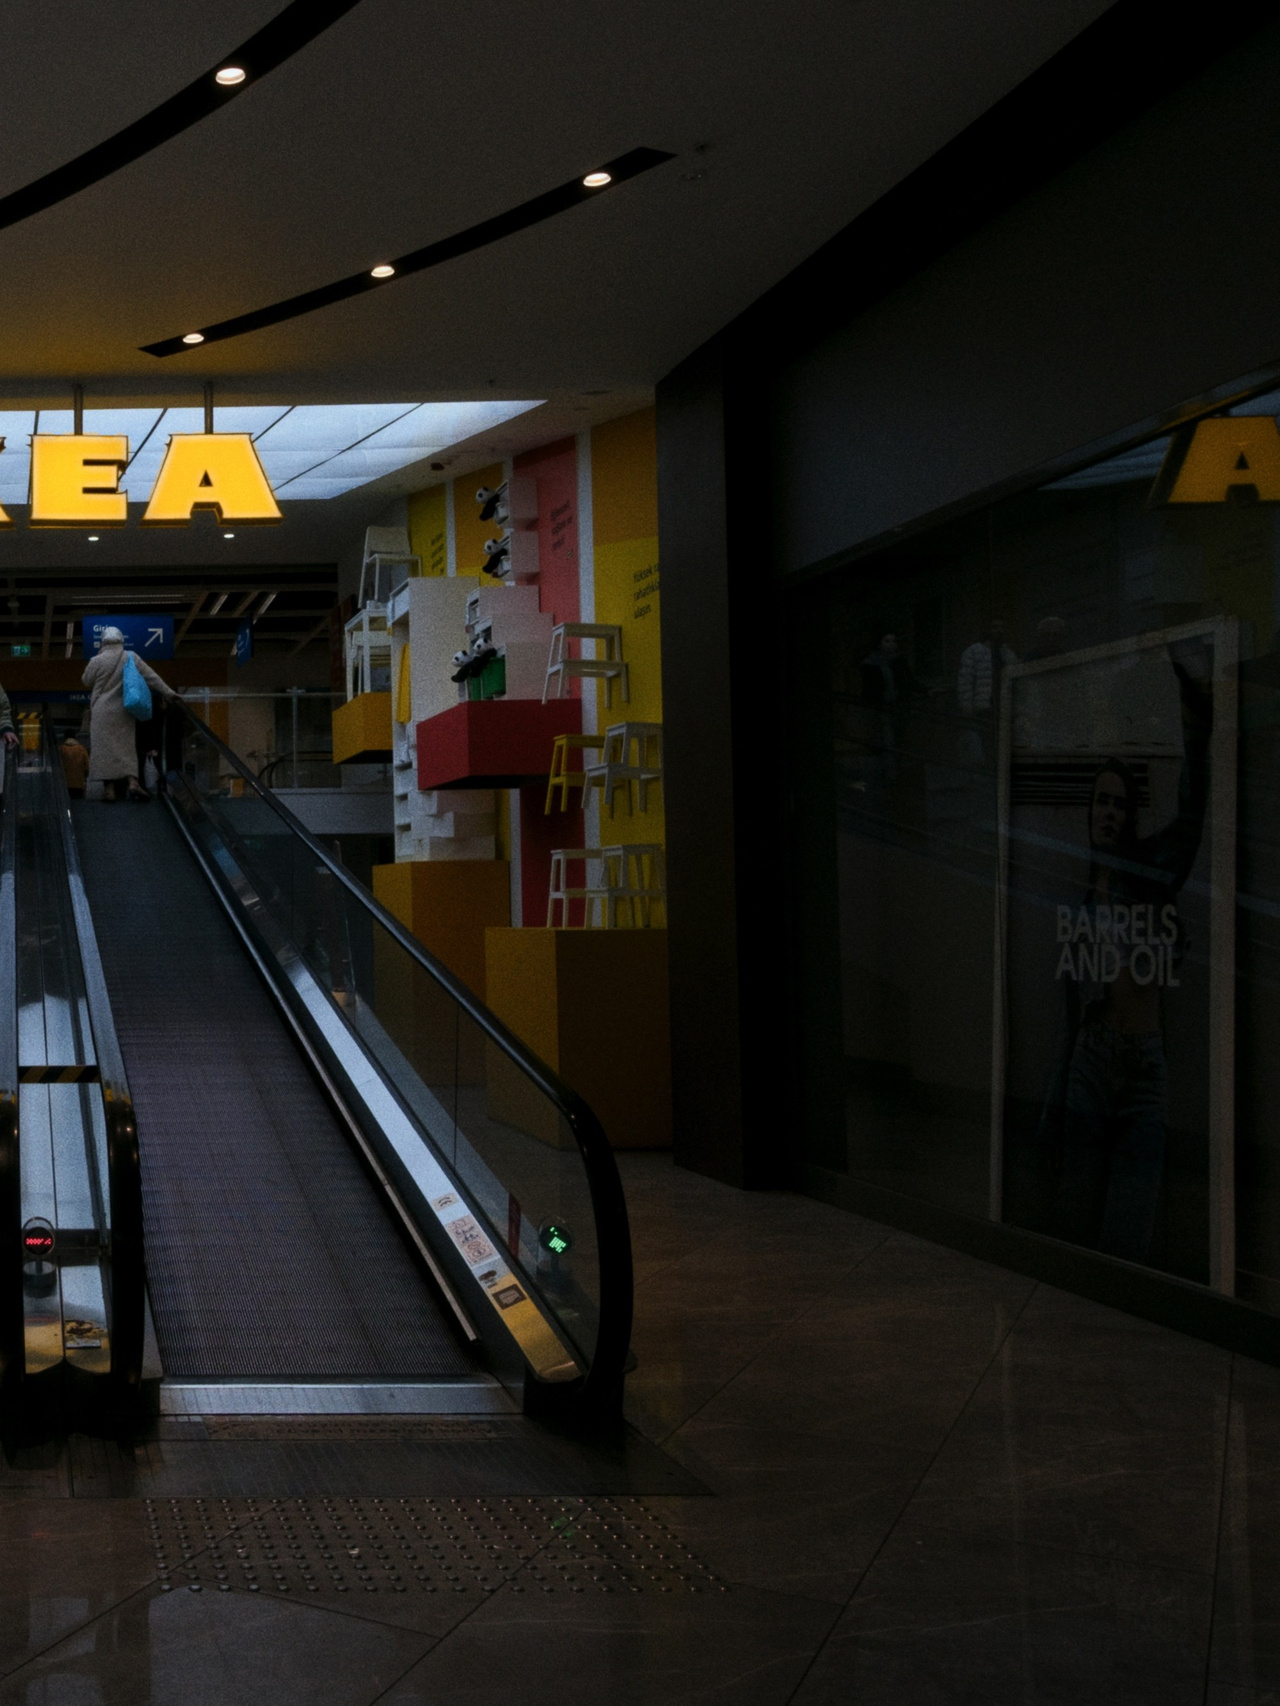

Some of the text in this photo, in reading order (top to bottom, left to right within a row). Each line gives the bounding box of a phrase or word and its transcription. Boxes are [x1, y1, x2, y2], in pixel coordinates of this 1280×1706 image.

[1056, 903, 1179, 946] BARRELS
[1054, 942, 1121, 983] AND
[1129, 944, 1181, 988] OIL
